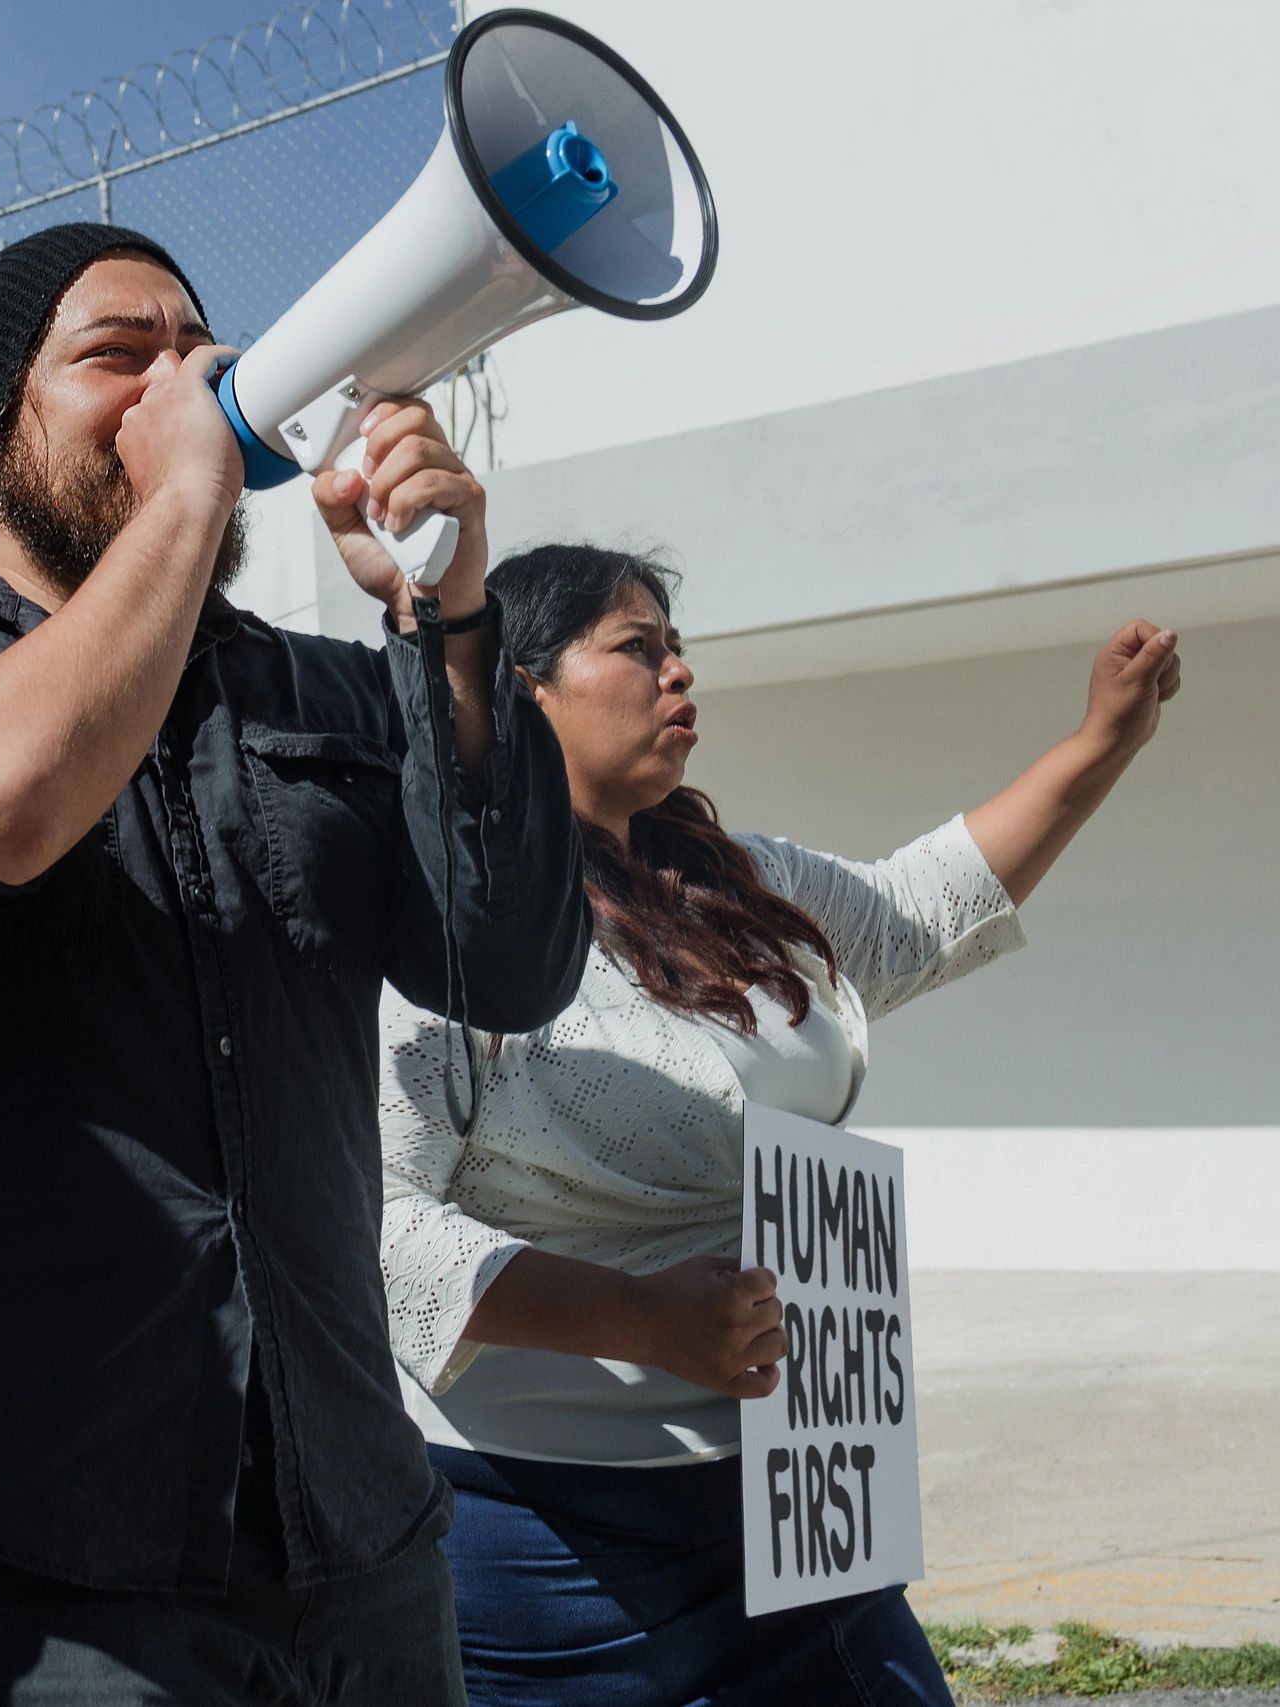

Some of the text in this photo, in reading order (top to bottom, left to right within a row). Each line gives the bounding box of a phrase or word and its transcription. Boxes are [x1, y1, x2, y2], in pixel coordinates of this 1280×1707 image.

[754, 1144, 898, 1298] HUMAN
[785, 1302, 905, 1431] RIGHTS
[766, 1441, 876, 1580] FIRST
